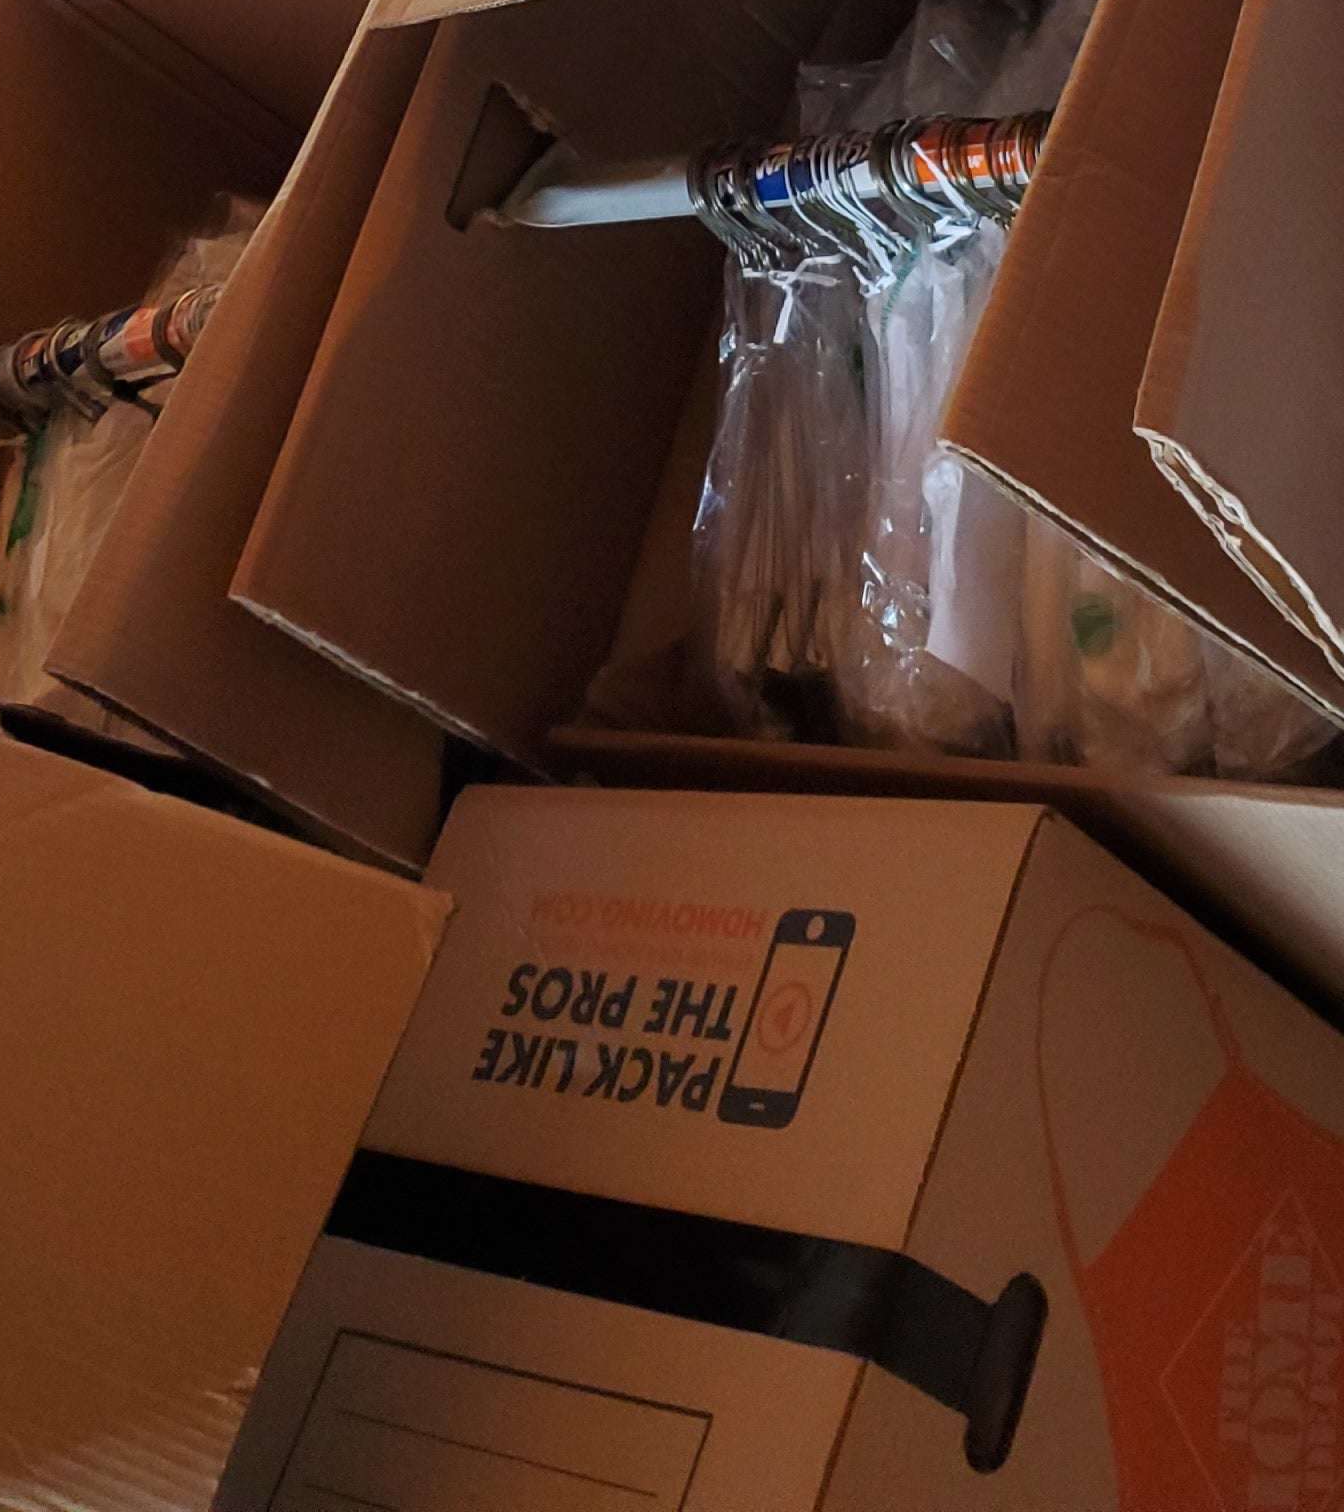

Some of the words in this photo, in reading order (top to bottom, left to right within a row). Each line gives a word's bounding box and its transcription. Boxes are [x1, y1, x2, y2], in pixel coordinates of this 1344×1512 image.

[501, 962, 639, 1029] PROS
[642, 977, 739, 1041] THE
[471, 1028, 578, 1092] LIKE
[582, 1042, 721, 1113] PACK
